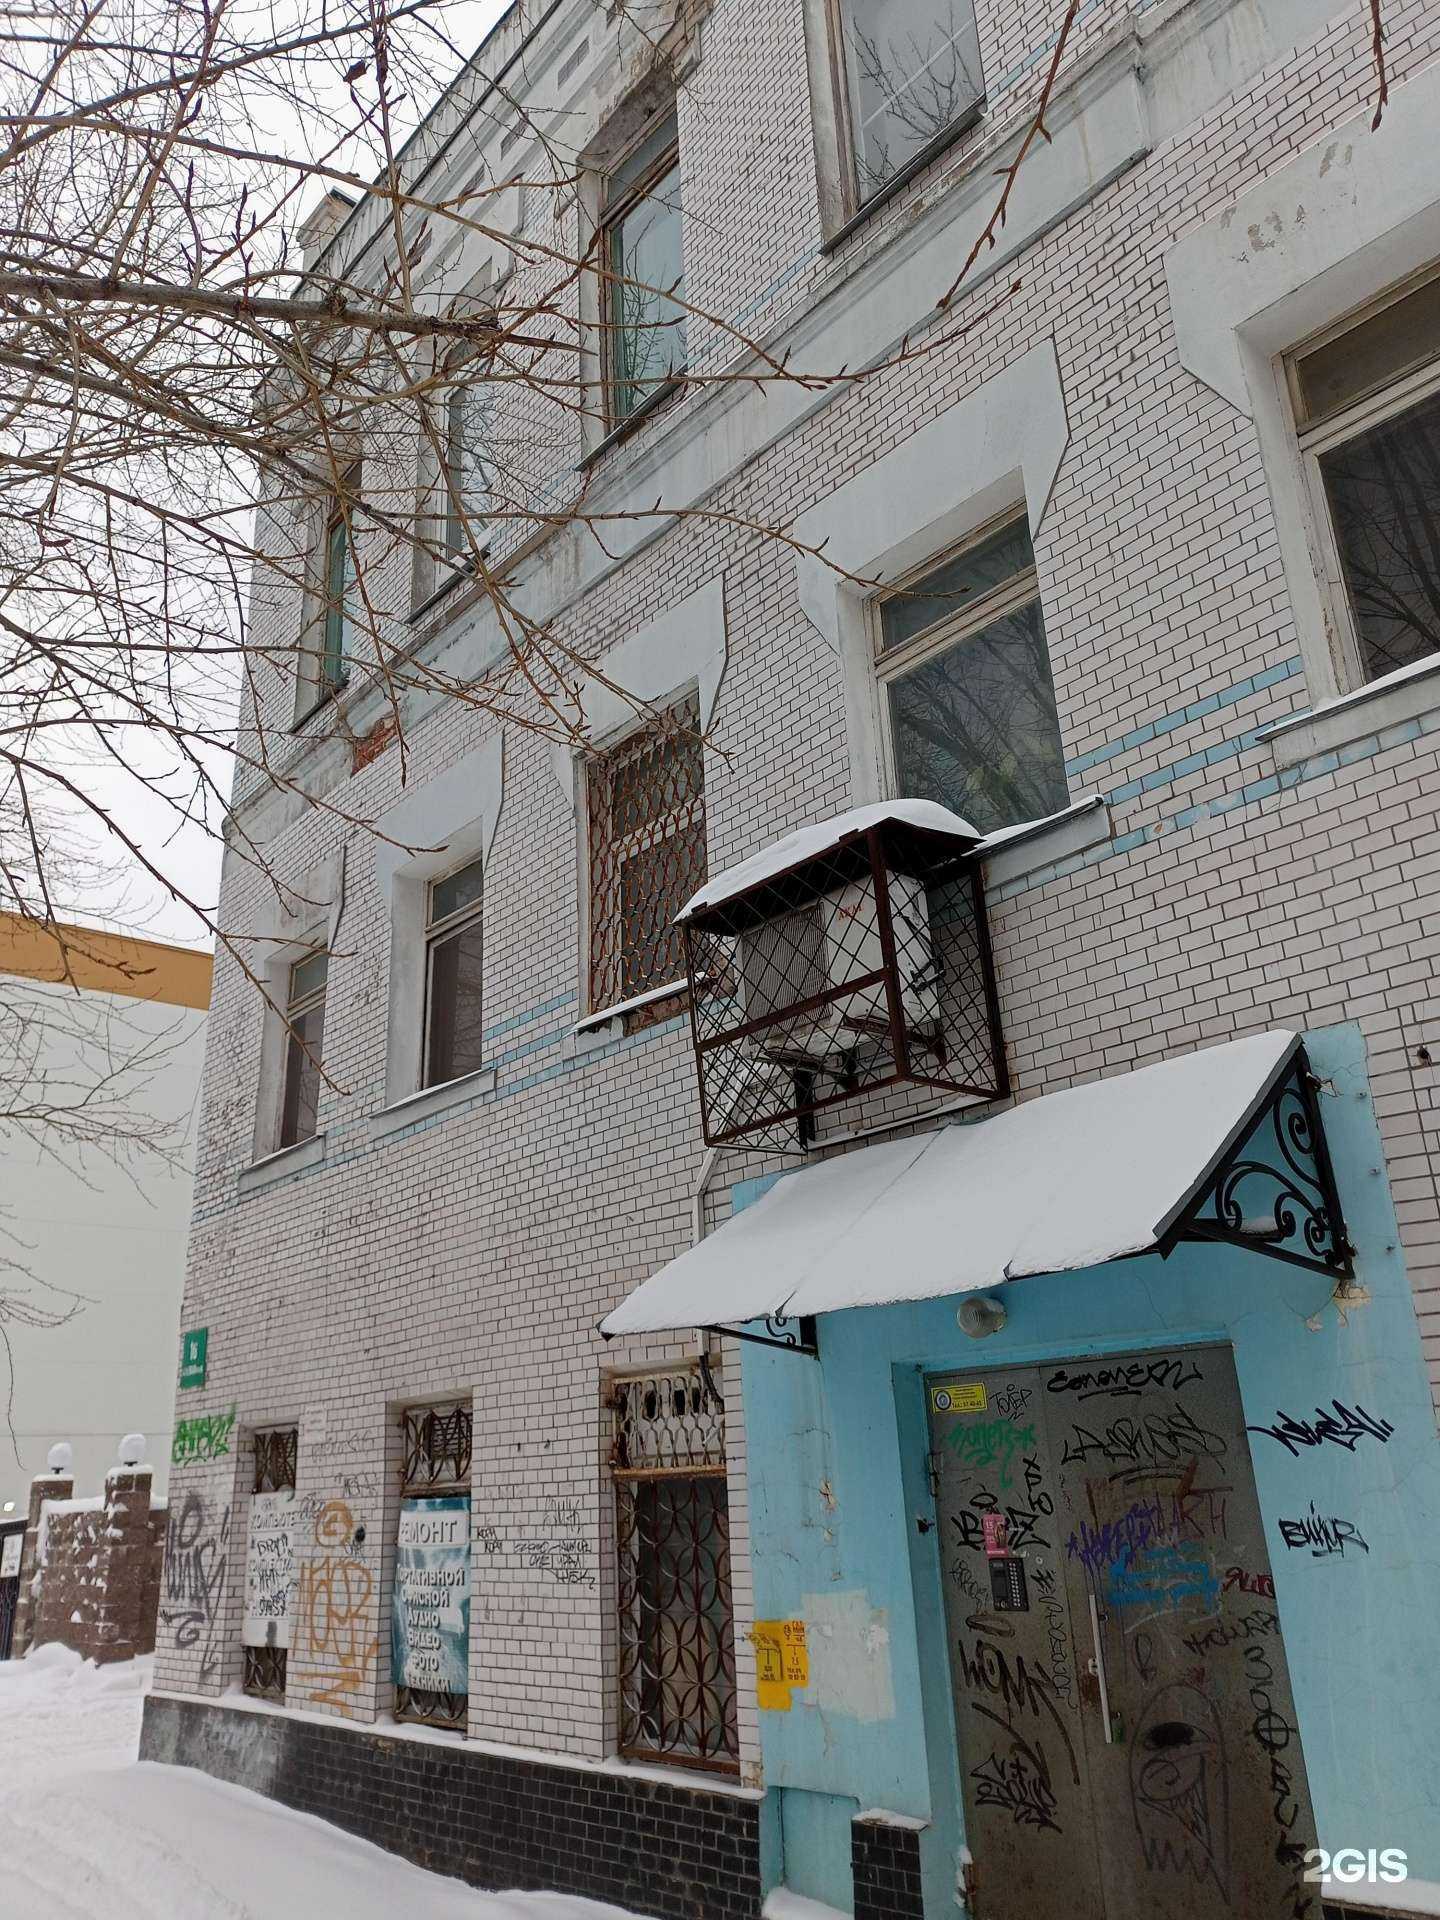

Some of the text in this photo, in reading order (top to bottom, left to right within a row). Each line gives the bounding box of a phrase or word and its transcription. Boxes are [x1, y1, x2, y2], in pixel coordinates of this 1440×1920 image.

[407, 1606, 441, 1629] АУДИО
[407, 1627, 441, 1650] ВИДЕО
[409, 1652, 440, 1672] ФОТО
